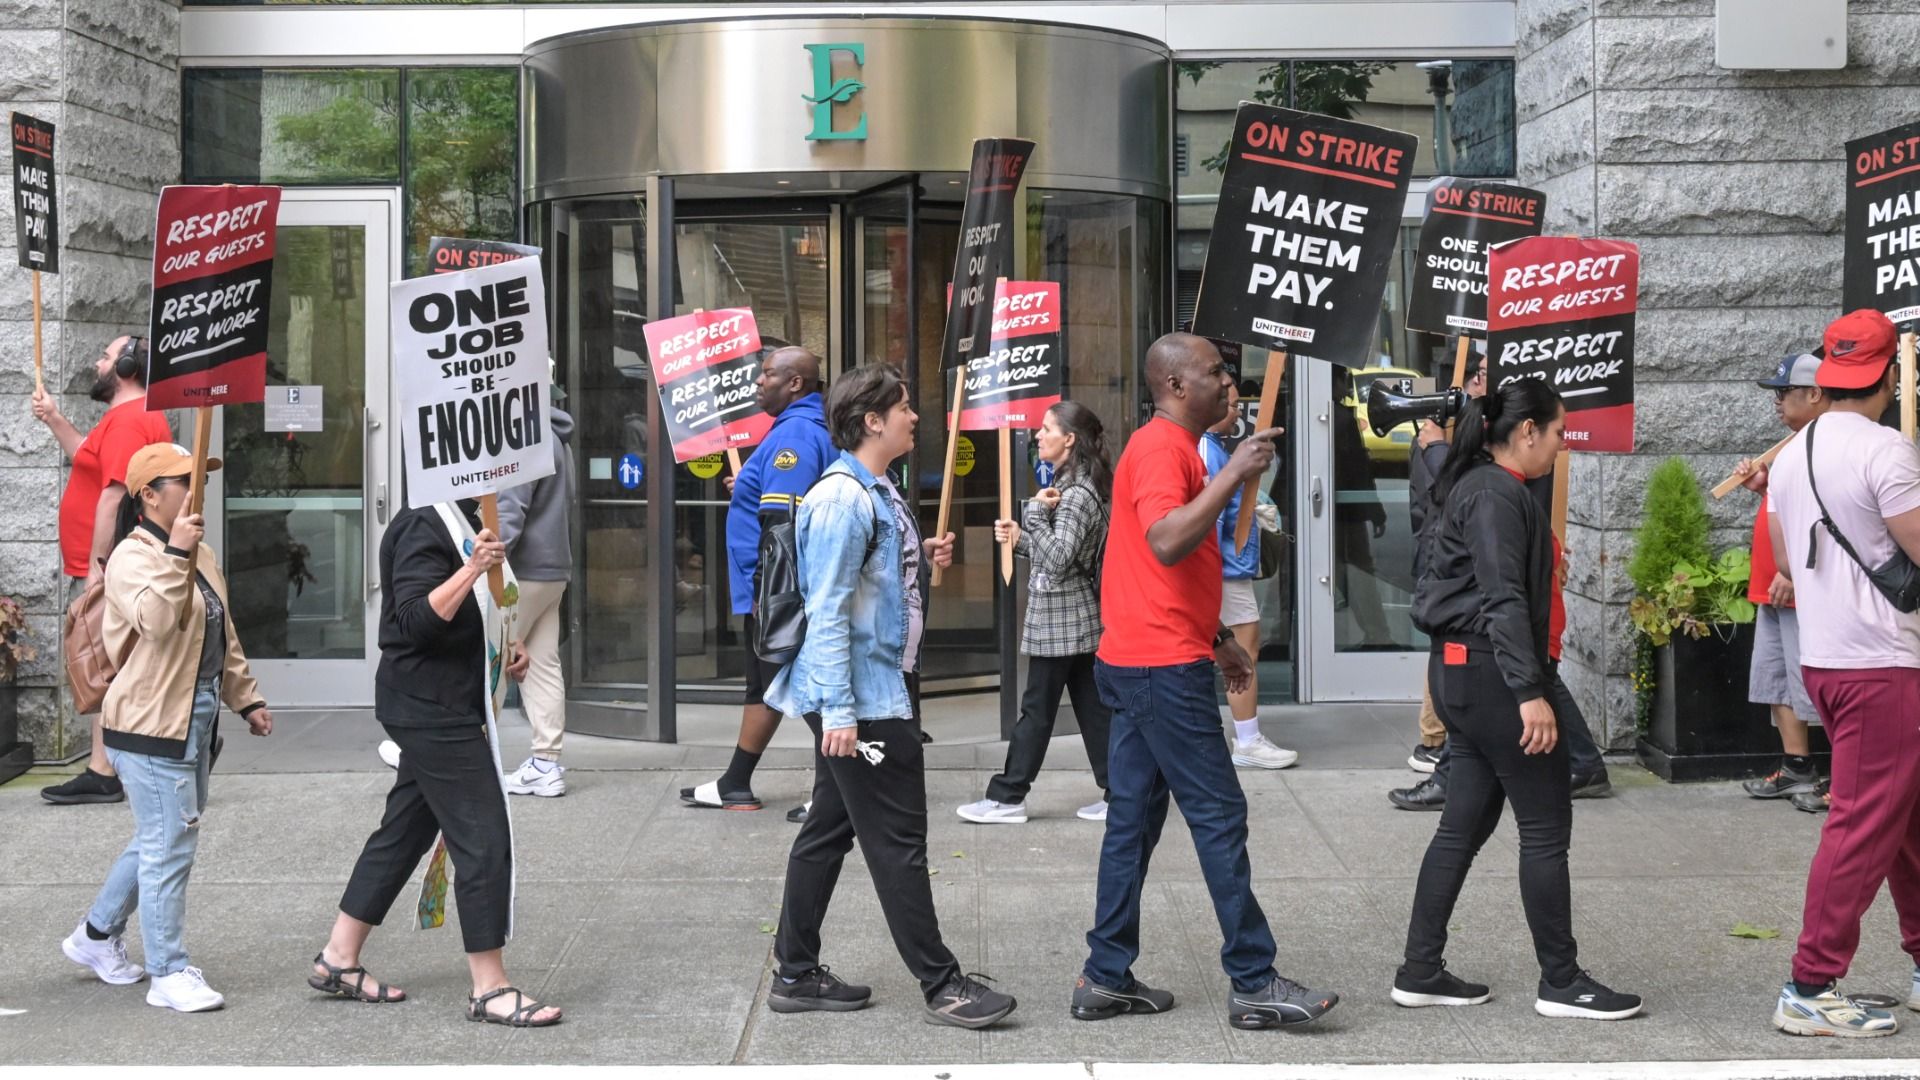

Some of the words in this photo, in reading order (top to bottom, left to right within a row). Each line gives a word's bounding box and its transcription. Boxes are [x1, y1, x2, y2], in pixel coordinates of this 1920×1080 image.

[802, 43, 868, 140] E
[14, 123, 26, 142] ON
[1246, 121, 1290, 153] ON
[1296, 130, 1404, 176] STRIKE
[20, 164, 48, 190] MAKE
[1856, 147, 1886, 174] ON
[20, 190, 50, 214] THEM
[1250, 186, 1369, 234] MAKE
[1434, 186, 1462, 206] ON
[1468, 190, 1537, 216] STRIKE
[1868, 190, 1920, 228] MA
[166, 200, 268, 246] RESPECT
[162, 250, 200, 274] OUR
[204, 231, 266, 264] GUESTS
[436, 248, 462, 266] ON
[1245, 223, 1362, 272] THEM
[1440, 236, 1479, 254] ONE
[1866, 224, 1920, 260] THE
[969, 255, 987, 276] OU
[1426, 254, 1488, 276] SHOUL
[1501, 254, 1626, 292] RESPECT
[160, 278, 261, 325] RESPECT
[992, 291, 1048, 314] PECT
[1247, 263, 1334, 310] PAY.
[1498, 298, 1543, 318] OUR
[1548, 284, 1626, 311] GUESTS
[408, 276, 530, 334] ONE
[158, 326, 200, 353] OUR
[206, 307, 260, 341] WORK
[426, 320, 524, 360] JOB
[660, 315, 743, 358] RESPECT
[1254, 320, 1313, 340] UNITEHERE!
[1498, 330, 1623, 366] RESPECT
[440, 350, 516, 378] SHOULD
[662, 355, 692, 376] OUR
[696, 333, 750, 361] GUESTS
[1554, 359, 1624, 386] WORK
[471, 374, 495, 394] BE
[672, 363, 756, 406] RESPECT
[998, 364, 1051, 384] WORK
[675, 400, 708, 424] OUR
[714, 382, 758, 408] WORK
[418, 382, 542, 470] ENOUGH
[451, 462, 520, 486] UNITEHERE!
